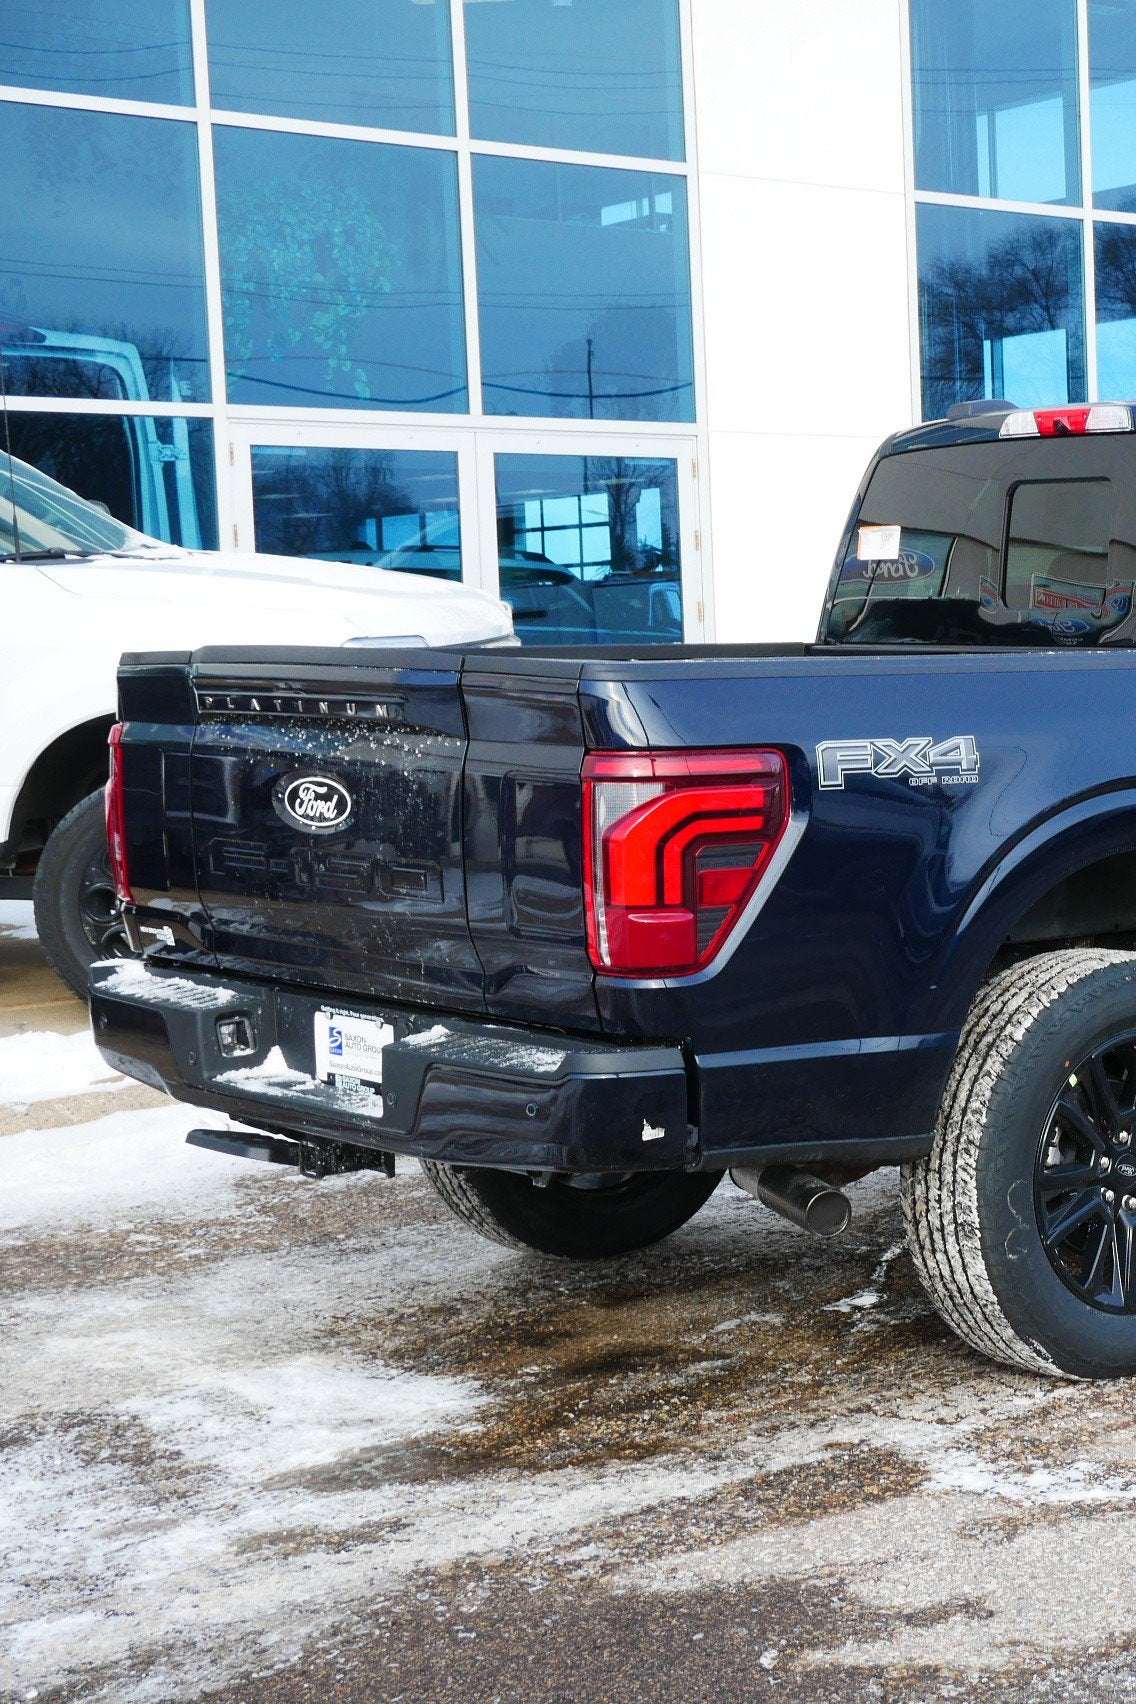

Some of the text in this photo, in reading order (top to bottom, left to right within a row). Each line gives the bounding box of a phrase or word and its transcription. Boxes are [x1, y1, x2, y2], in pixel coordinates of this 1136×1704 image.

[203, 696, 390, 718] PLATINUM
[816, 735, 980, 790] FX4
[908, 774, 979, 786] OFF ROAD
[294, 782, 338, 820] Ford
[344, 1033, 367, 1044] SAXON
[344, 1042, 382, 1054] AUTO GROU
[329, 1060, 382, 1075] SaxonAutoGroup.co
